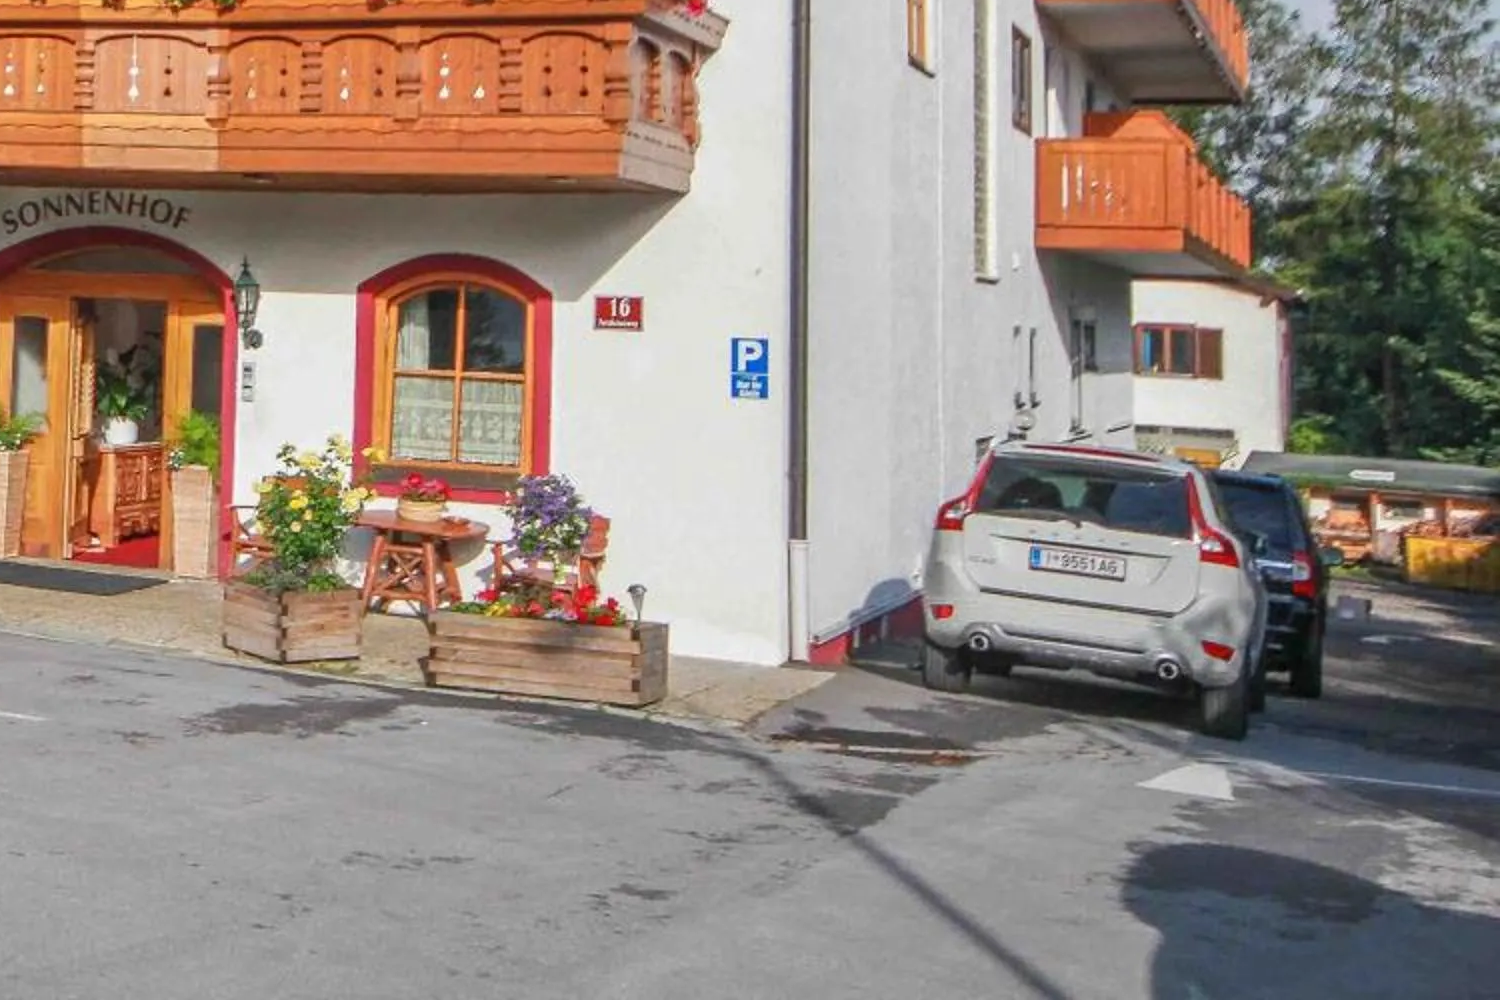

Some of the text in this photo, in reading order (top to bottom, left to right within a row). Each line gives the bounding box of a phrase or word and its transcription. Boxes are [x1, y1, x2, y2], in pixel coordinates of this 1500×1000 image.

[2, 190, 192, 234] SONNENHOF
[611, 297, 630, 317] 16
[737, 340, 763, 371] P
